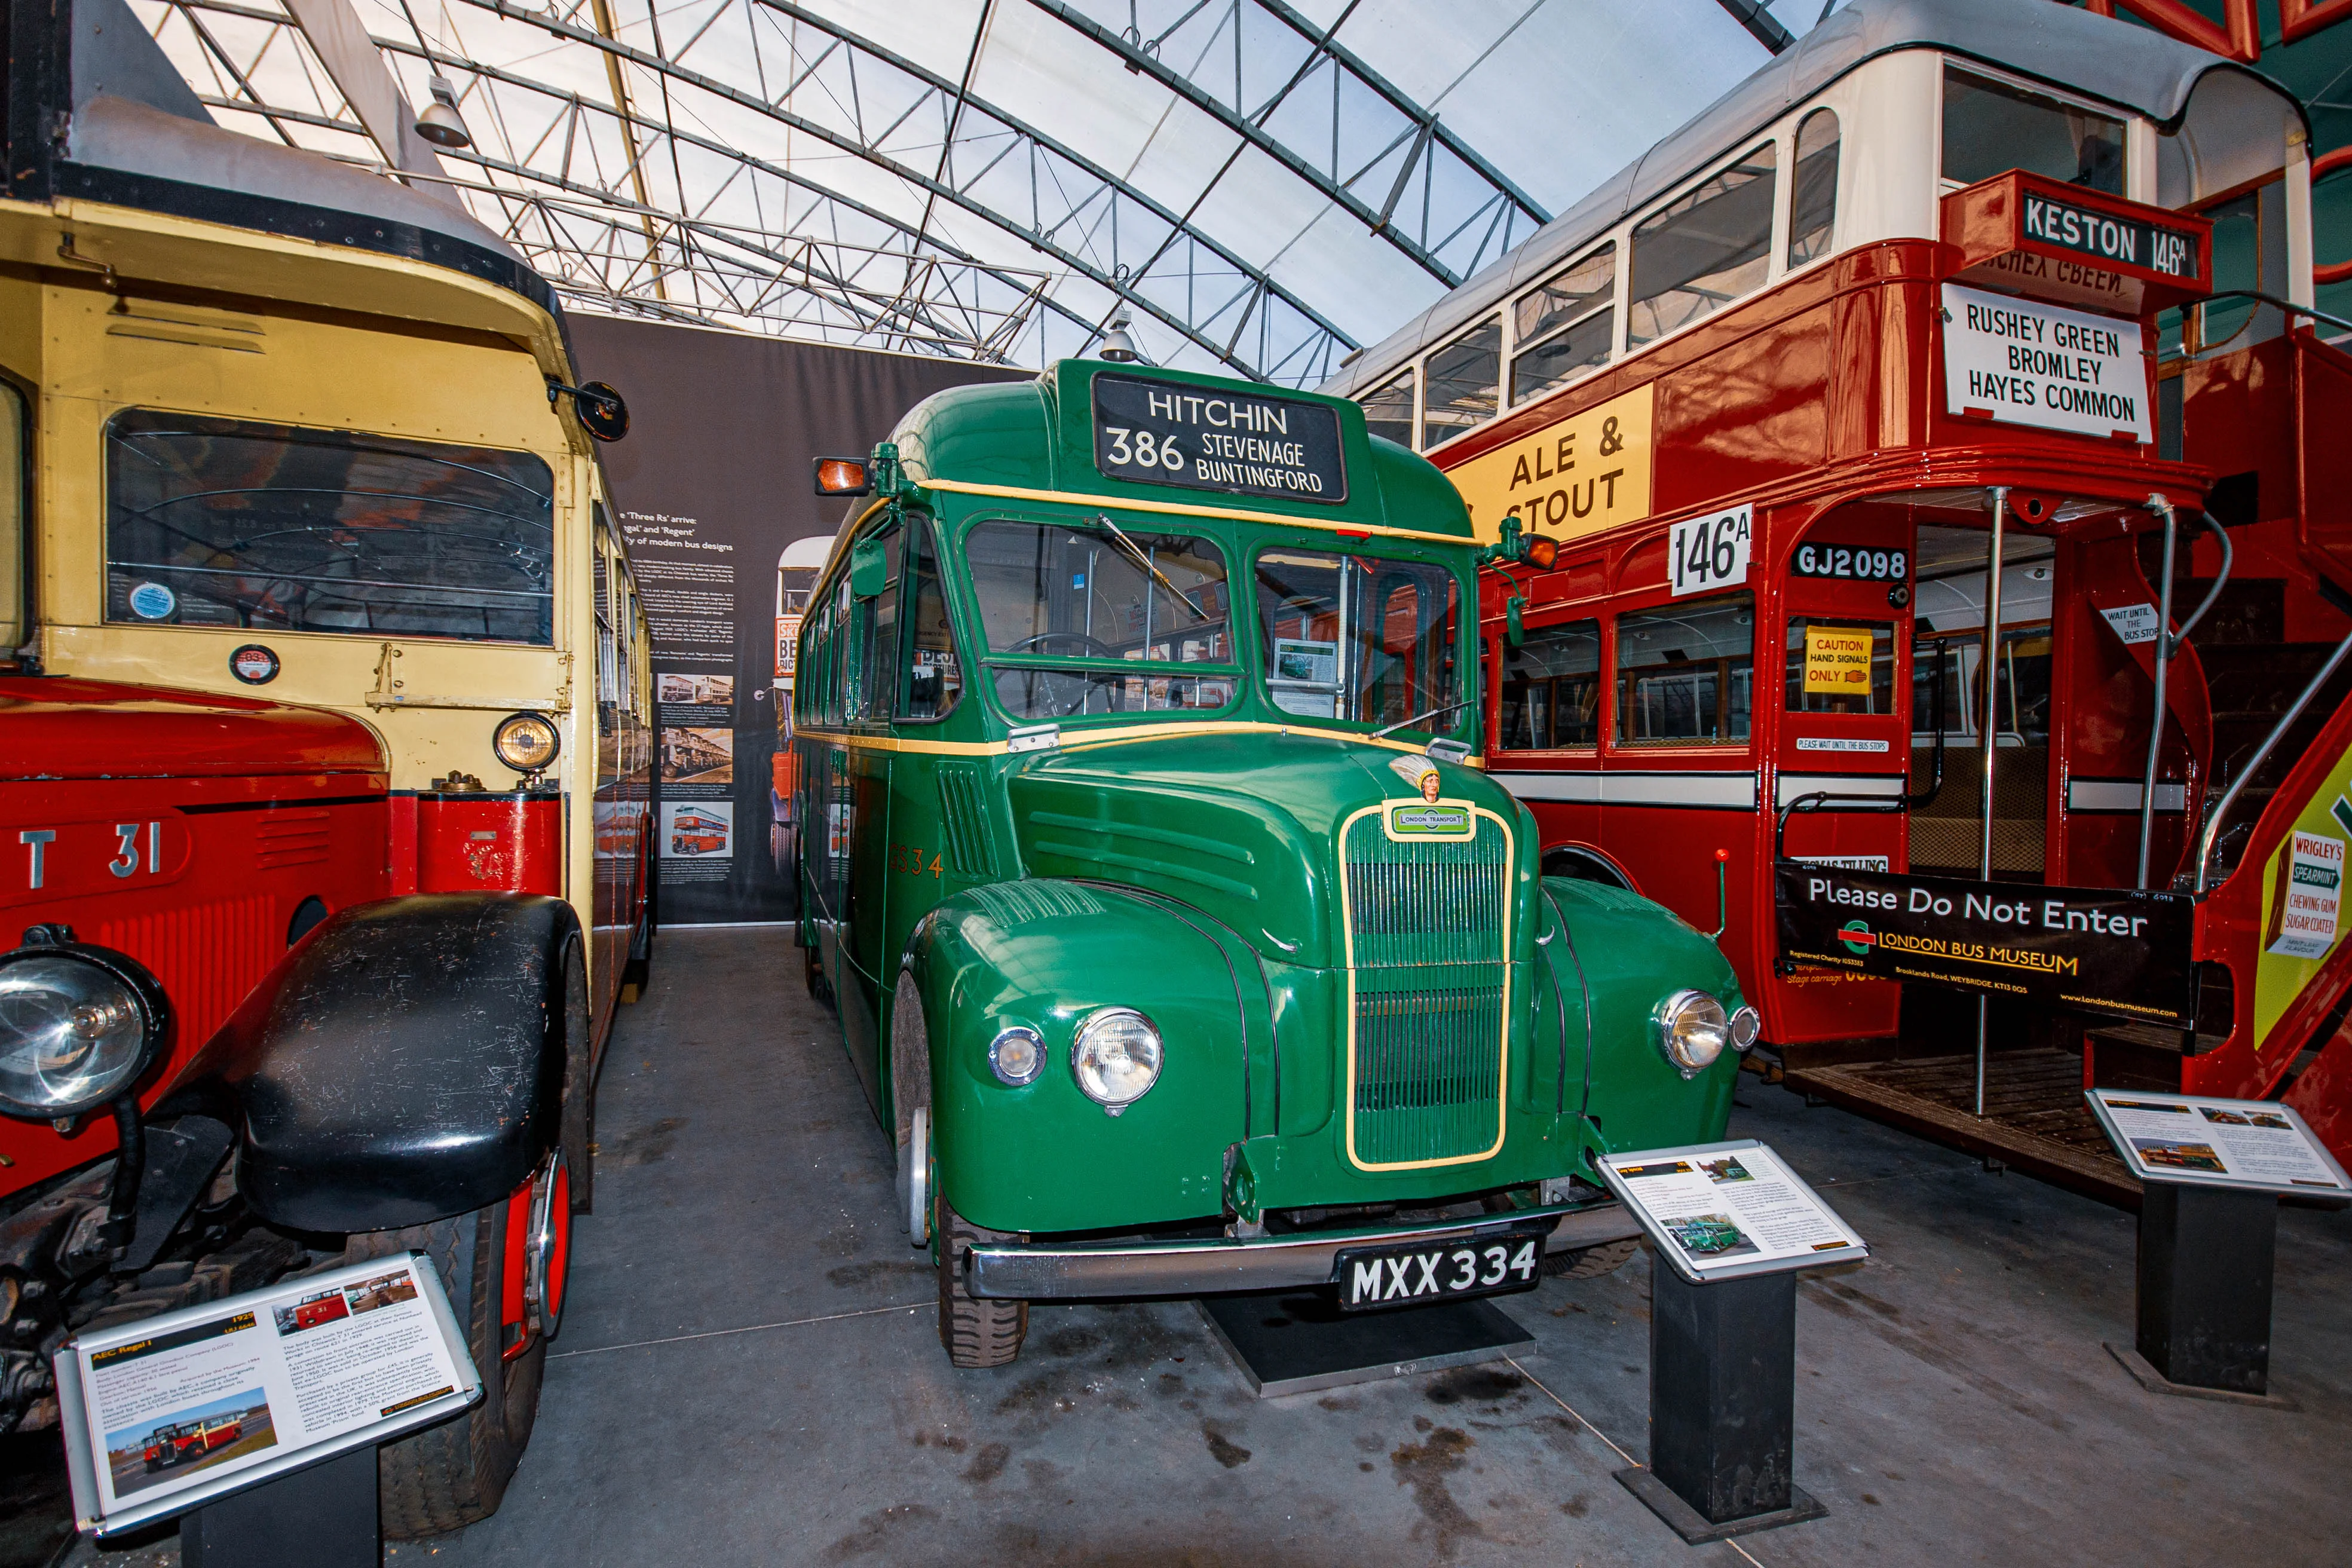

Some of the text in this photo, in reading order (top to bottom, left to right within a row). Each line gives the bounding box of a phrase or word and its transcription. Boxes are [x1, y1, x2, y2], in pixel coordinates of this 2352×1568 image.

[2028, 198, 2186, 276] KESTON 146A
[1967, 304, 2120, 357] RUSHEY GREEN
[2008, 345, 2102, 385] BROMLEY
[1970, 370, 2135, 422] HAYES COMMON
[1149, 391, 1287, 434] HITCHIN
[1106, 427, 1304, 470] 386 STEVENAGE
[1509, 416, 1624, 491] ALE &
[1196, 458, 1322, 492] BUNTINGFORD
[649, 538, 683, 547] modern
[702, 542, 733, 552] designs
[1676, 511, 1750, 587] 146A
[1799, 546, 1906, 578] GJ2098
[2108, 607, 2149, 620] WAIT UNTIL
[2127, 619, 2141, 628] THE
[1817, 639, 1864, 651] CAUTION
[2124, 630, 2139, 640] BUS
[1810, 654, 1868, 664] HAND SIGNALS
[1809, 670, 1840, 682] ONLY
[1799, 739, 1817, 749] PLEASE
[1818, 740, 1832, 749] WAIT
[1832, 740, 1846, 749] UNTIL
[1848, 741, 1858, 749] THE
[1870, 742, 1886, 750] STOPS
[20, 821, 161, 889] T 31
[2295, 837, 2342, 860] WRIGLEY'S
[2293, 866, 2336, 885] SPEARMINT
[1810, 878, 2148, 938] Please Do Not Enter
[2289, 894, 2336, 914] CHEWING GUM
[2285, 913, 2334, 934] SUGAR COATED
[1789, 950, 1820, 960] Registered
[1821, 954, 1841, 964] Charity
[1879, 932, 2078, 976] LONDON BUS MUSEUM
[1787, 974, 1809, 988] Stage
[1895, 966, 1930, 978] Brooklands
[1931, 972, 1950, 981] Road,
[1995, 982, 2011, 991] KT13
[1352, 1241, 1536, 1304] MXX 334
[232, 1312, 253, 1324] 1929
[91, 1349, 117, 1361] AEC
[119, 1342, 145, 1355] Regal
[284, 1346, 303, 1355] Works
[351, 1326, 372, 1334] entered
[296, 1386, 325, 1398] Purchased
[339, 1376, 359, 1385] private
[411, 1352, 433, 1362] generally
[298, 1392, 323, 1404] accepted
[410, 1357, 432, 1367] privately
[299, 1396, 327, 1408] preserved
[376, 1369, 411, 1383] subsequently
[411, 1363, 428, 1371] totally
